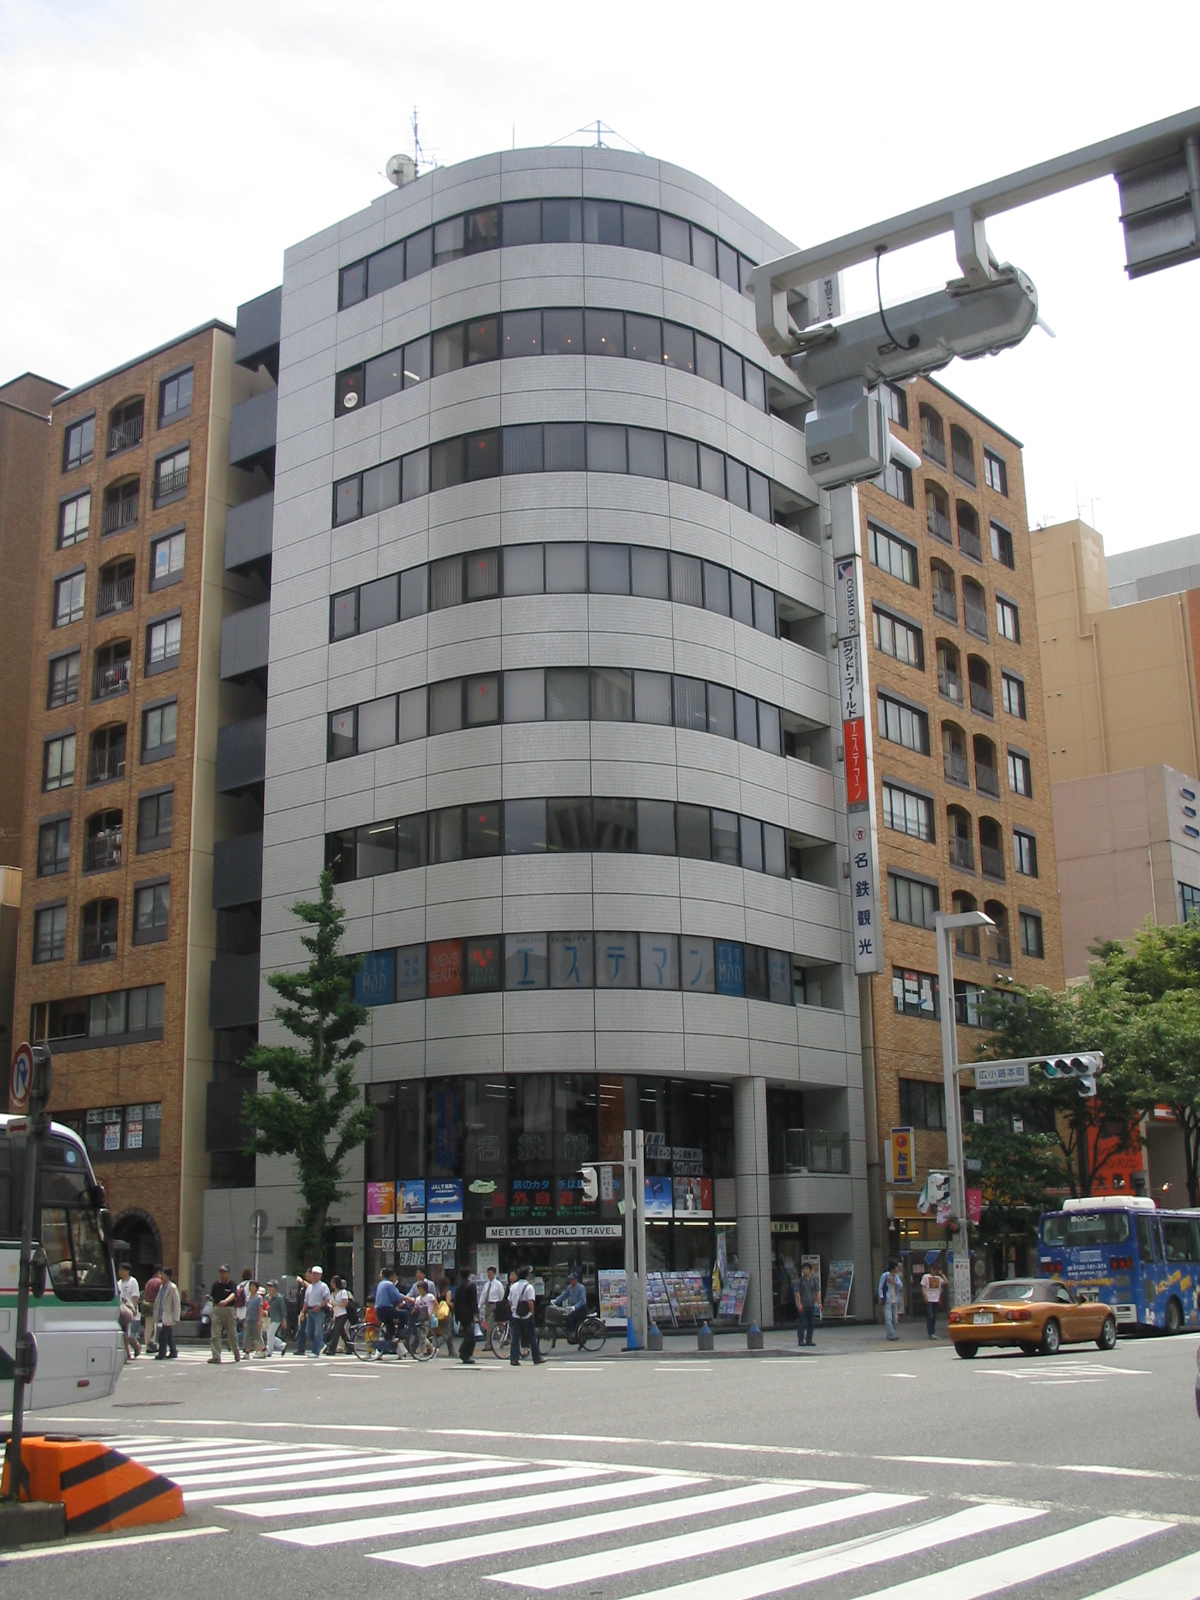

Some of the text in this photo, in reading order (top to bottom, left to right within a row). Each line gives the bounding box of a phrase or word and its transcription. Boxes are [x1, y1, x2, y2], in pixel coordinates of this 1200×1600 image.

[847, 578, 856, 633] COSMO FX
[851, 721, 862, 799] エステマン
[855, 852, 872, 955] 名鉄観光
[429, 968, 461, 983] BEAUTY
[517, 945, 703, 986] エステマン
[979, 1067, 1025, 1080] 広小路本町
[478, 1133, 622, 1161] 名鉄観光
[491, 1226, 617, 1236] MEITETSU WORLD TRAVEL
